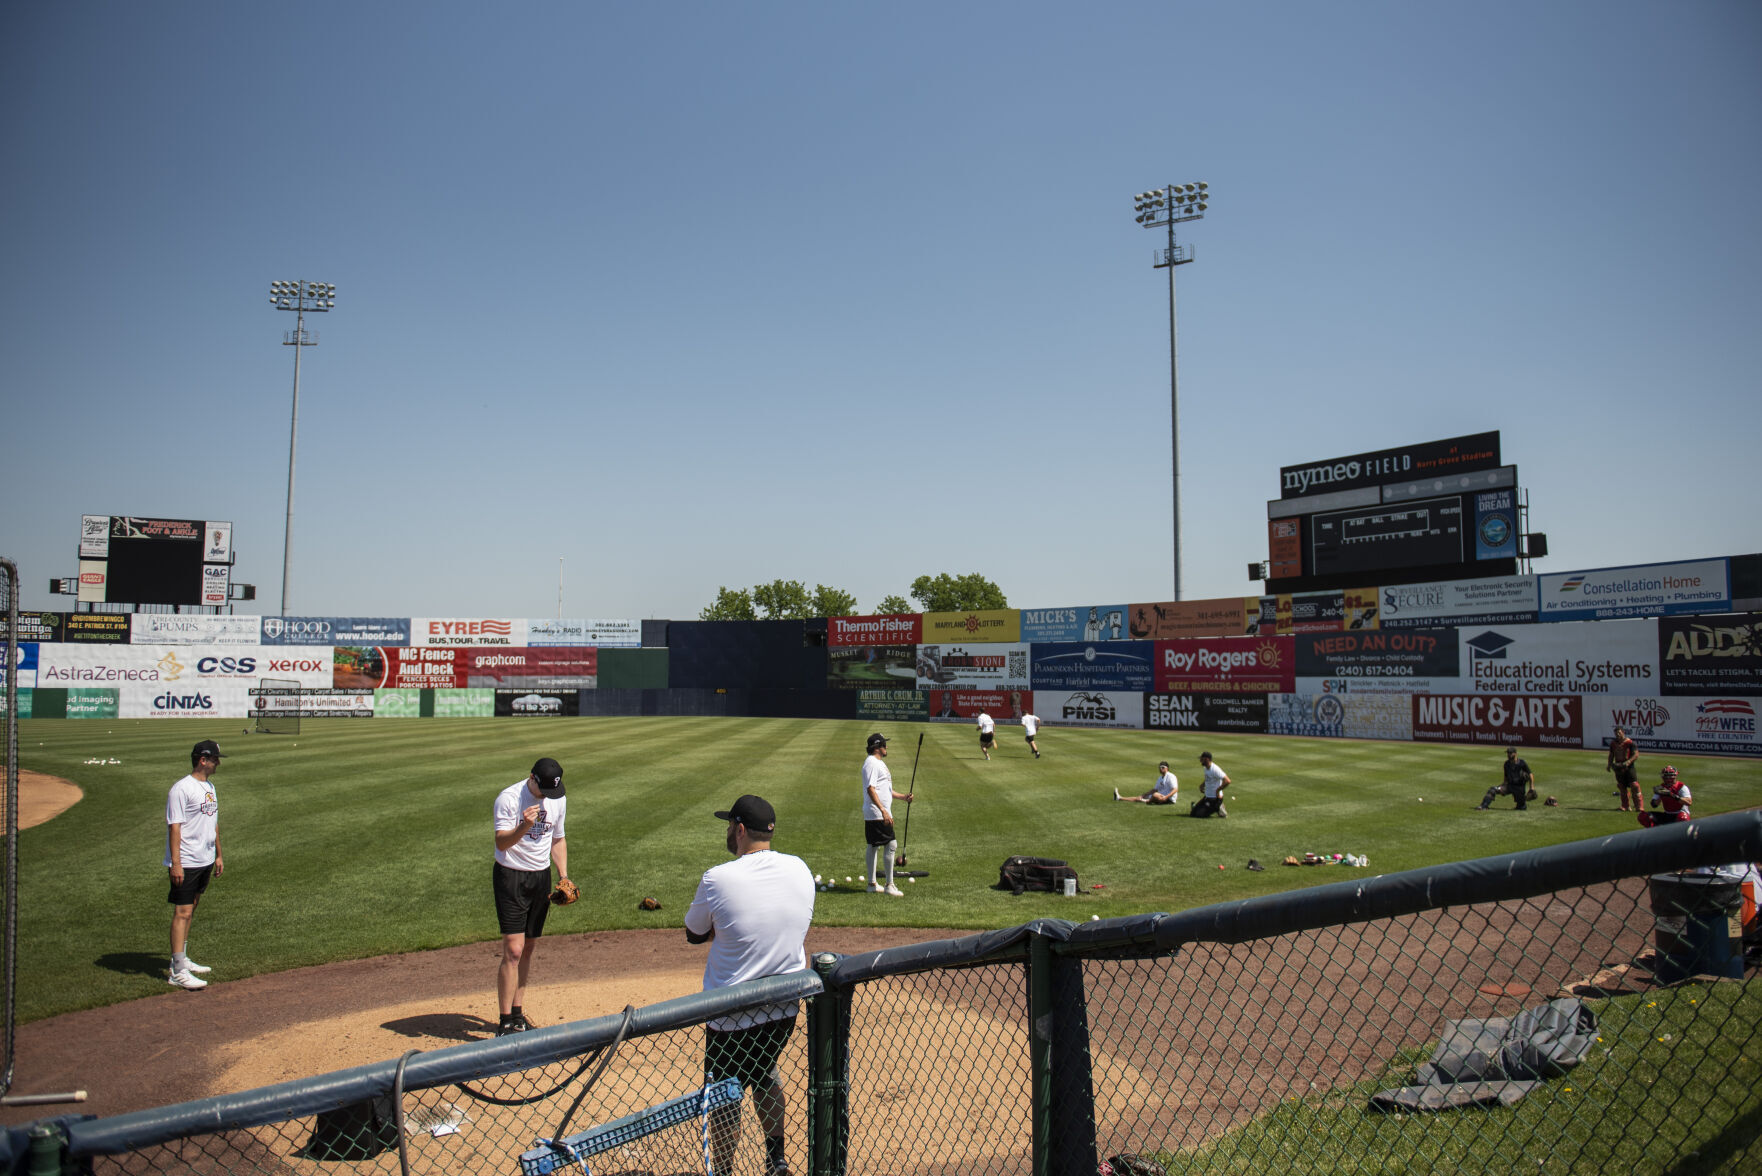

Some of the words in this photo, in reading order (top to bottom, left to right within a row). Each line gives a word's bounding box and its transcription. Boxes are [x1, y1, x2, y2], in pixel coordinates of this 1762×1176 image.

[1438, 456, 1459, 465] Grove
[1461, 451, 1493, 462] Stadium
[1284, 461, 1361, 493] nymeo
[1366, 455, 1411, 477] FIELD
[1499, 491, 1510, 499] THE
[1479, 499, 1511, 511] DREAM
[148, 520, 192, 529] FREDERICK
[172, 528, 198, 536] ANKLE
[205, 568, 227, 576] GAC
[1454, 585, 1469, 593] Your
[1471, 583, 1502, 591] Electronic
[1504, 580, 1532, 590] Security
[1583, 578, 1662, 596] Constellation
[1663, 576, 1701, 589] Home
[1464, 591, 1495, 600] Solutions
[1497, 589, 1522, 598] Partner
[1560, 597, 1617, 609] Conditioning
[1626, 594, 1664, 605] Heating
[1674, 591, 1722, 601] Plumbing
[1026, 610, 1077, 624] MICK'S
[1596, 606, 1665, 617] 888-243-HOME
[935, 621, 965, 629] MARYLAND
[1440, 614, 1532, 625] SurveillanceSecure.com
[159, 622, 199, 632] PUMPS
[284, 621, 331, 633] HOOD
[429, 621, 480, 635] EYRE
[335, 632, 404, 641] www.hood.edu
[478, 637, 511, 645] TRAVEL
[837, 633, 913, 642] SCIENTIFIC
[1313, 636, 1358, 656] NEED
[1361, 635, 1387, 651] AN
[1391, 634, 1437, 653] OUT?
[399, 648, 418, 660] MC
[420, 648, 455, 661] Fence
[831, 649, 857, 658] MUSKET
[886, 649, 911, 658] RIDGE
[1401, 654, 1424, 662] Custody
[268, 659, 322, 672] xerox
[475, 653, 526, 668] graphcom
[1165, 649, 1196, 672] Roy
[1198, 648, 1257, 672] Rogers
[399, 662, 422, 675] And
[424, 662, 454, 675] Deck
[1034, 663, 1075, 672] PLAMONDON
[1075, 662, 1116, 672] HOSPITALITY
[1116, 662, 1150, 672] PARTNERS
[1335, 665, 1363, 676] (240)
[1365, 665, 1414, 676] 617-0404
[1474, 659, 1569, 679] Educational
[1575, 660, 1652, 683] Systems
[1666, 668, 1687, 676] LET'S
[1687, 668, 1716, 676] TACKLE
[1718, 668, 1753, 676] STIGMA.
[45, 665, 159, 681] AstraZeneca
[1168, 681, 1190, 691] BEEF,
[1191, 681, 1231, 691] BURGERS
[1233, 682, 1240, 690] &
[1242, 681, 1280, 691] CHICKEN
[1322, 680, 1347, 693] SPH
[1475, 680, 1521, 692] Federal
[1524, 680, 1564, 693] Credit
[1568, 680, 1609, 693] Union
[860, 690, 886, 699] ARTHUR
[78, 696, 114, 705] Imaging
[275, 697, 314, 707] Hamilton's
[316, 697, 351, 707] Unlimited
[1149, 695, 1193, 710] SEAN
[1635, 699, 1657, 710] 930
[66, 704, 99, 712] Partner
[1419, 696, 1483, 726] MUSIC
[1487, 697, 1510, 727] &
[1512, 697, 1571, 729] ARTS
[1149, 711, 1199, 727] BRINK
[1217, 719, 1260, 727] seanbrink.com
[1612, 709, 1666, 727] WFMD
[1720, 717, 1755, 730] WFRE
[1414, 730, 1445, 739] Instruments
[1475, 732, 1497, 741] Rentals
[1502, 732, 1523, 742] Repairs
[1539, 733, 1582, 745] MusicArts.com
[1697, 732, 1715, 740] FREE
[1718, 733, 1753, 741] COUNTRY
[1658, 740, 1667, 748] AT
[1669, 741, 1713, 750] WFMD.COM
